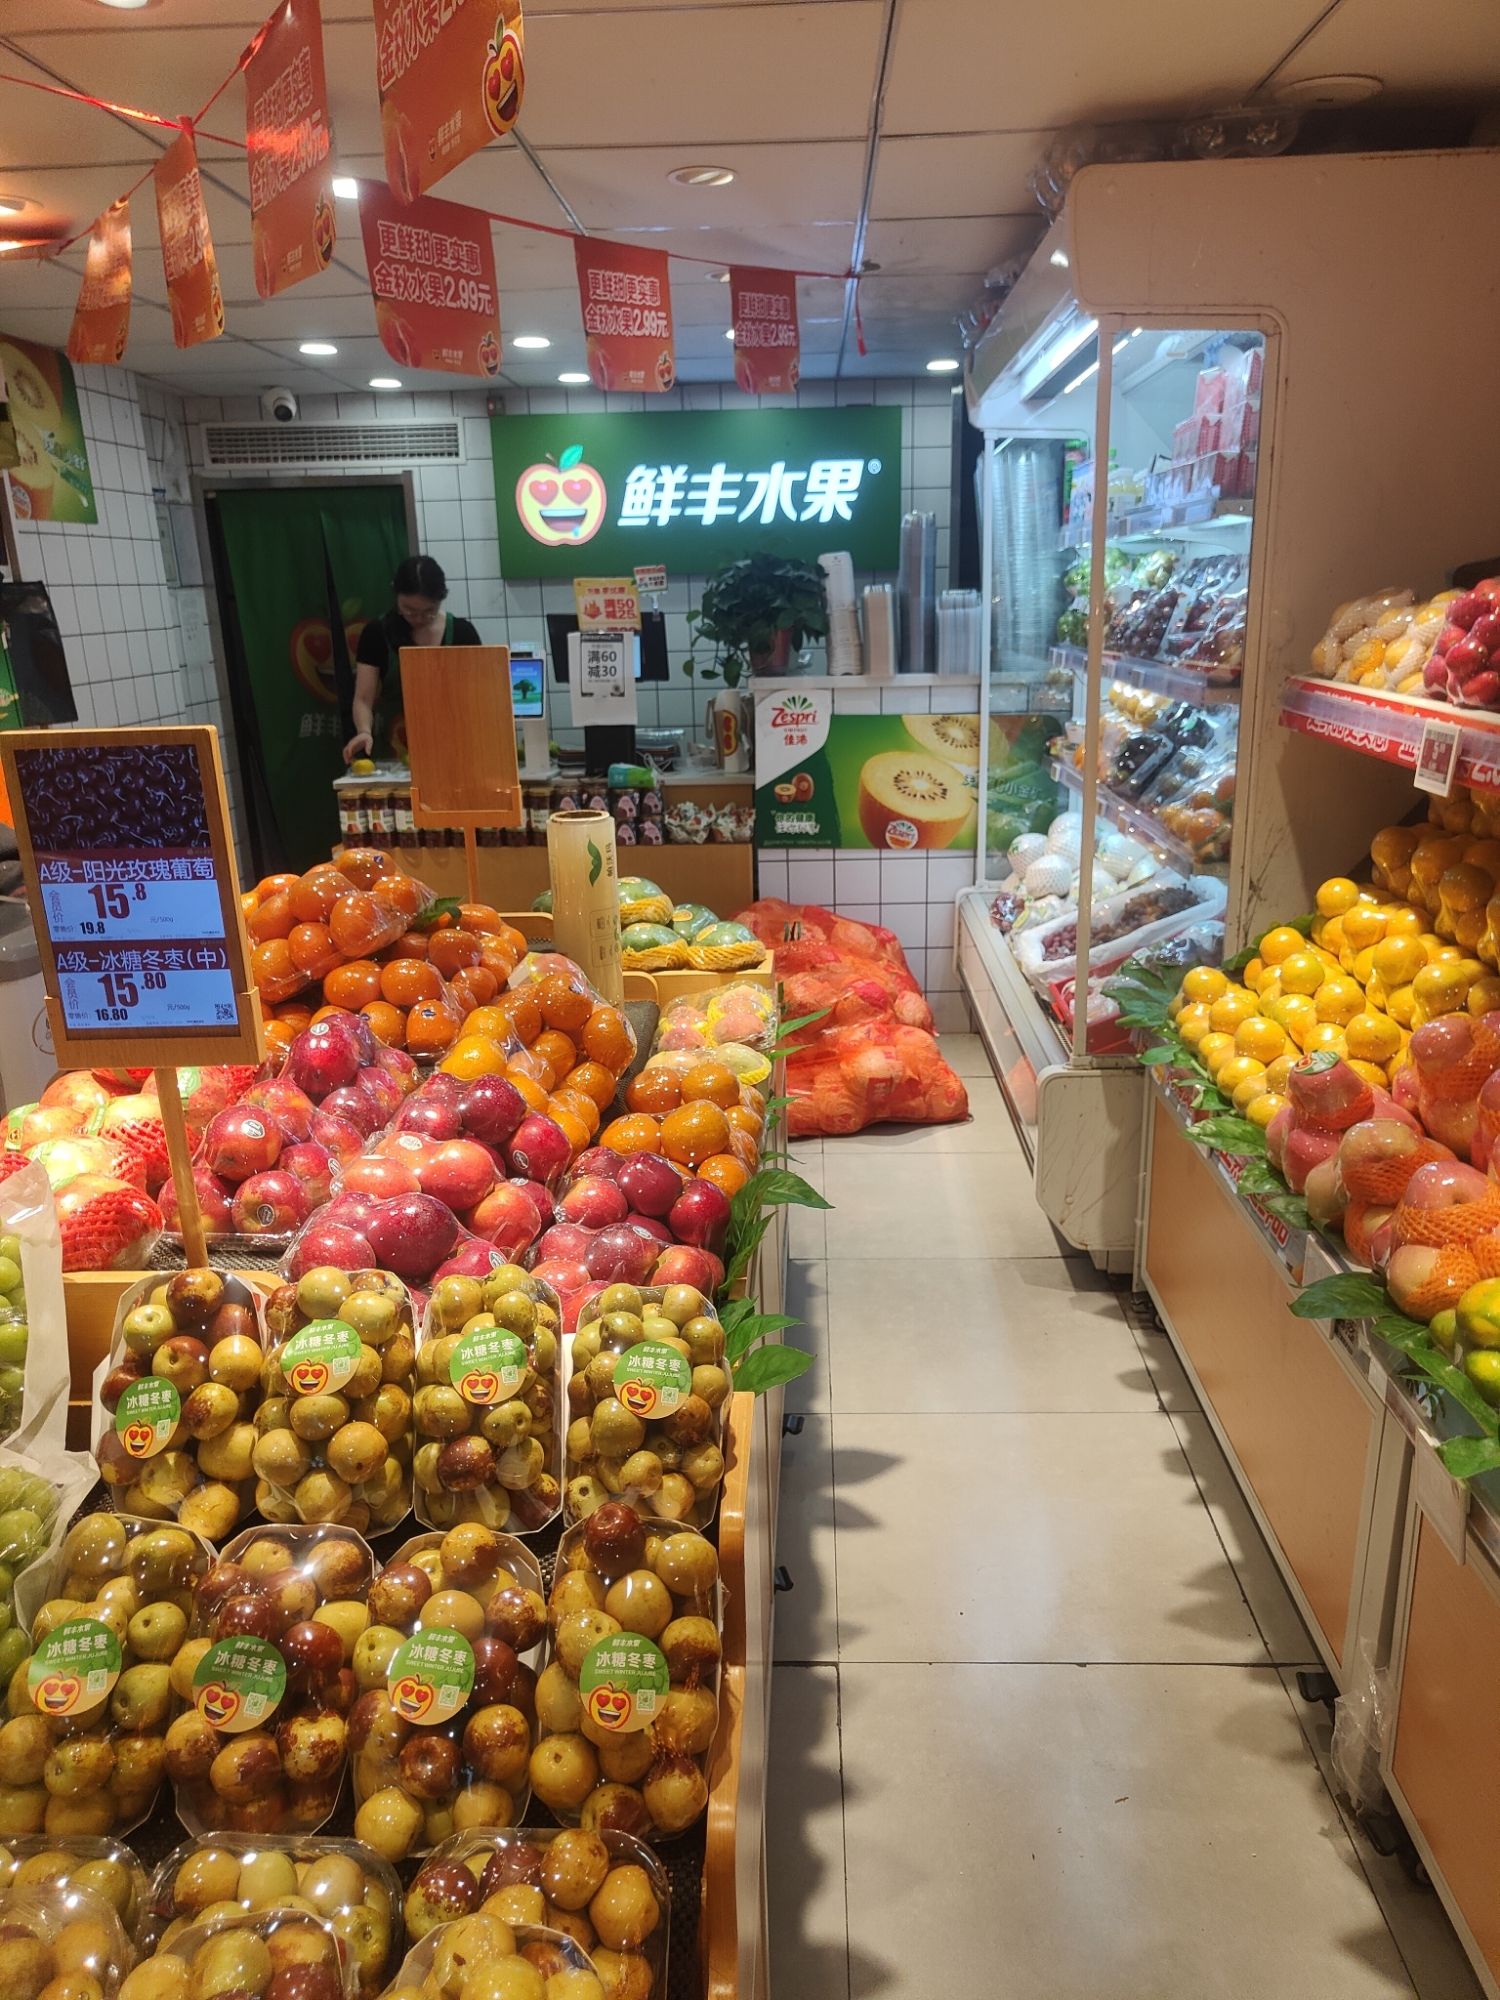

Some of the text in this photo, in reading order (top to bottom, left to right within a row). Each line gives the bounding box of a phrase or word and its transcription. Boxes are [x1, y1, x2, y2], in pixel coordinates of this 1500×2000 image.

[377, 220, 482, 276] 更鲜甜 更实惠
[617, 458, 865, 526] 鲜丰水果
[588, 650, 617, 664] 满60
[588, 665, 617, 679] 减30
[771, 707, 818, 728] Zespri
[40, 857, 214, 882] A级-阳光玫瑰葡萄
[80, 921, 106, 935] 19.8
[57, 948, 227, 972] A级-冰糖冬枣(中)
[98, 971, 167, 1007] 15.80
[96, 1008, 128, 1021] 16.80
[295, 1330, 349, 1350] 冰糖冬枣
[461, 1338, 514, 1360] 冰糖冬枣
[628, 1355, 681, 1372] 冰糖冬枣
[126, 1389, 172, 1409] 冰糖冬枣
[47, 1634, 107, 1658] 冰糖冬枣
[408, 1643, 468, 1666] 冰糖冬枣
[214, 1650, 278, 1675] 冰糖冬枣
[596, 1651, 656, 1669] 冰糖冬枣
